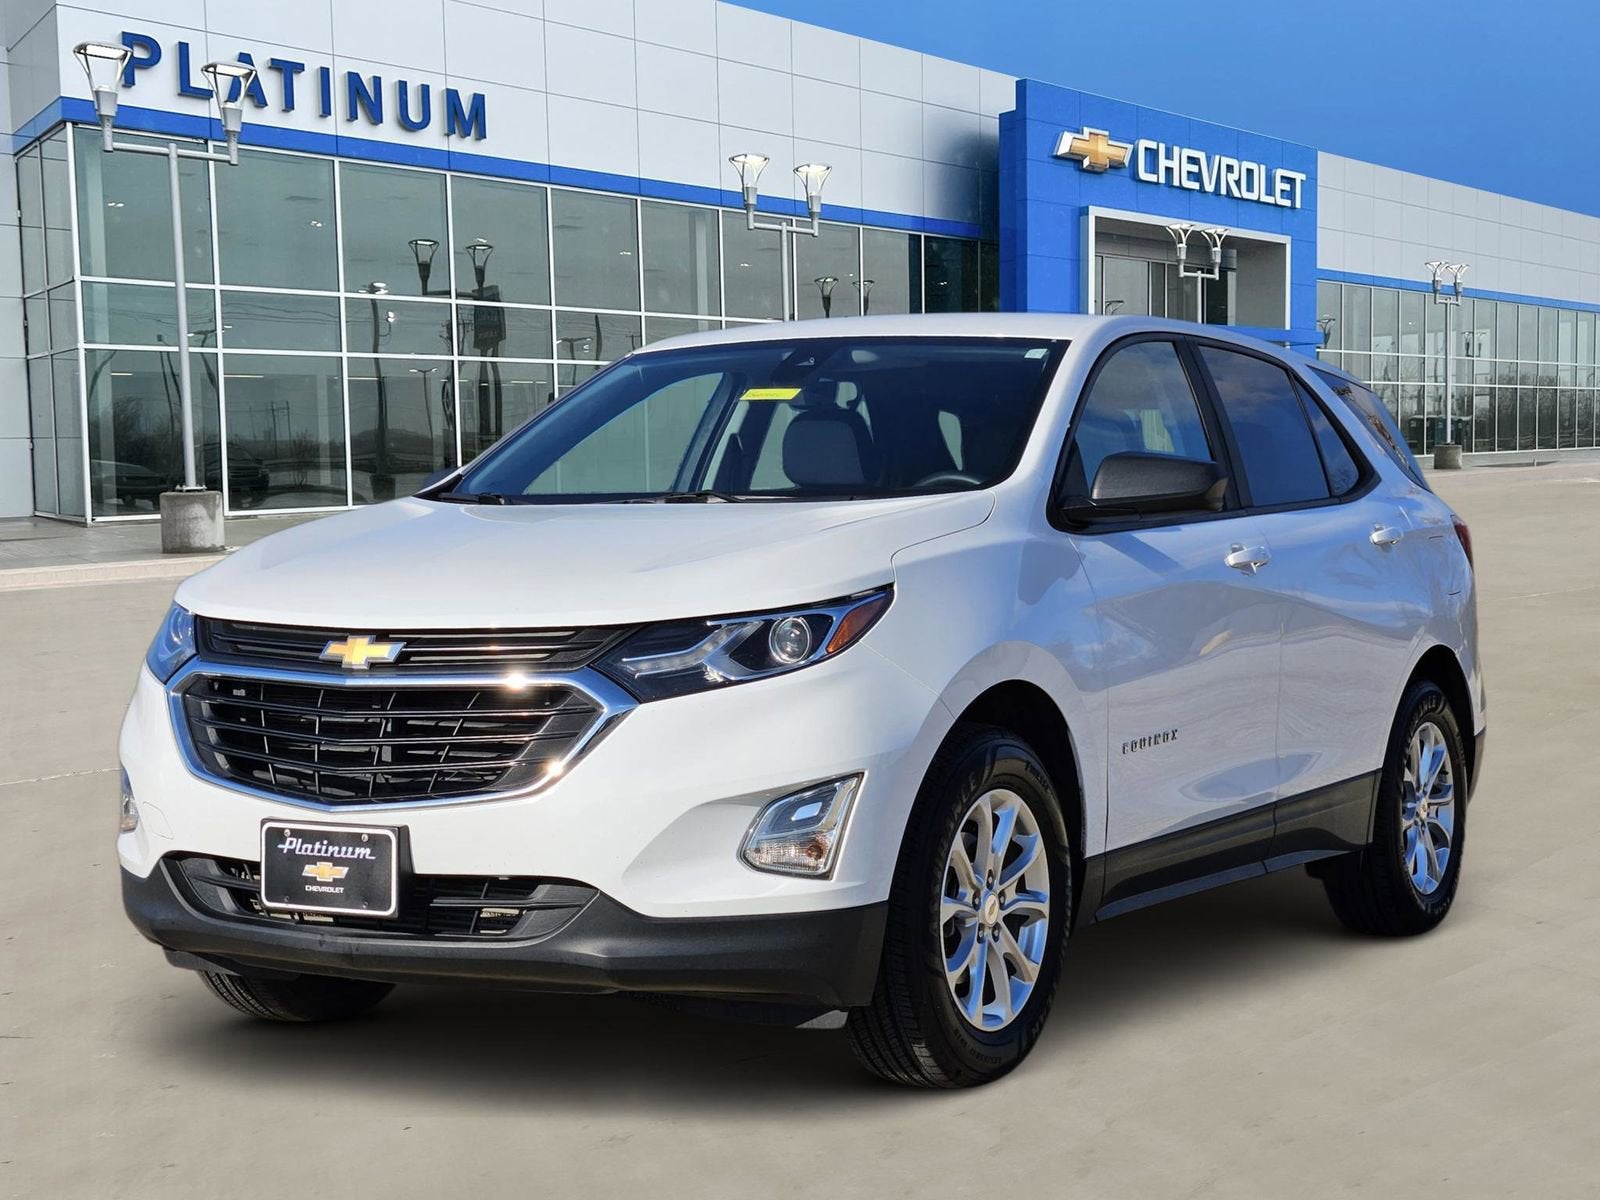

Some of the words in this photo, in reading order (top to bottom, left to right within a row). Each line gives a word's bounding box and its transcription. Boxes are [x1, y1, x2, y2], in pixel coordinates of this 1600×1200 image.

[121, 31, 487, 140] PLATINUM
[1137, 138, 1306, 209] CHEVROLET
[1122, 728, 1178, 755] EQUINOX
[277, 837, 376, 860] Platinum
[305, 885, 345, 894] CHEVROLET
